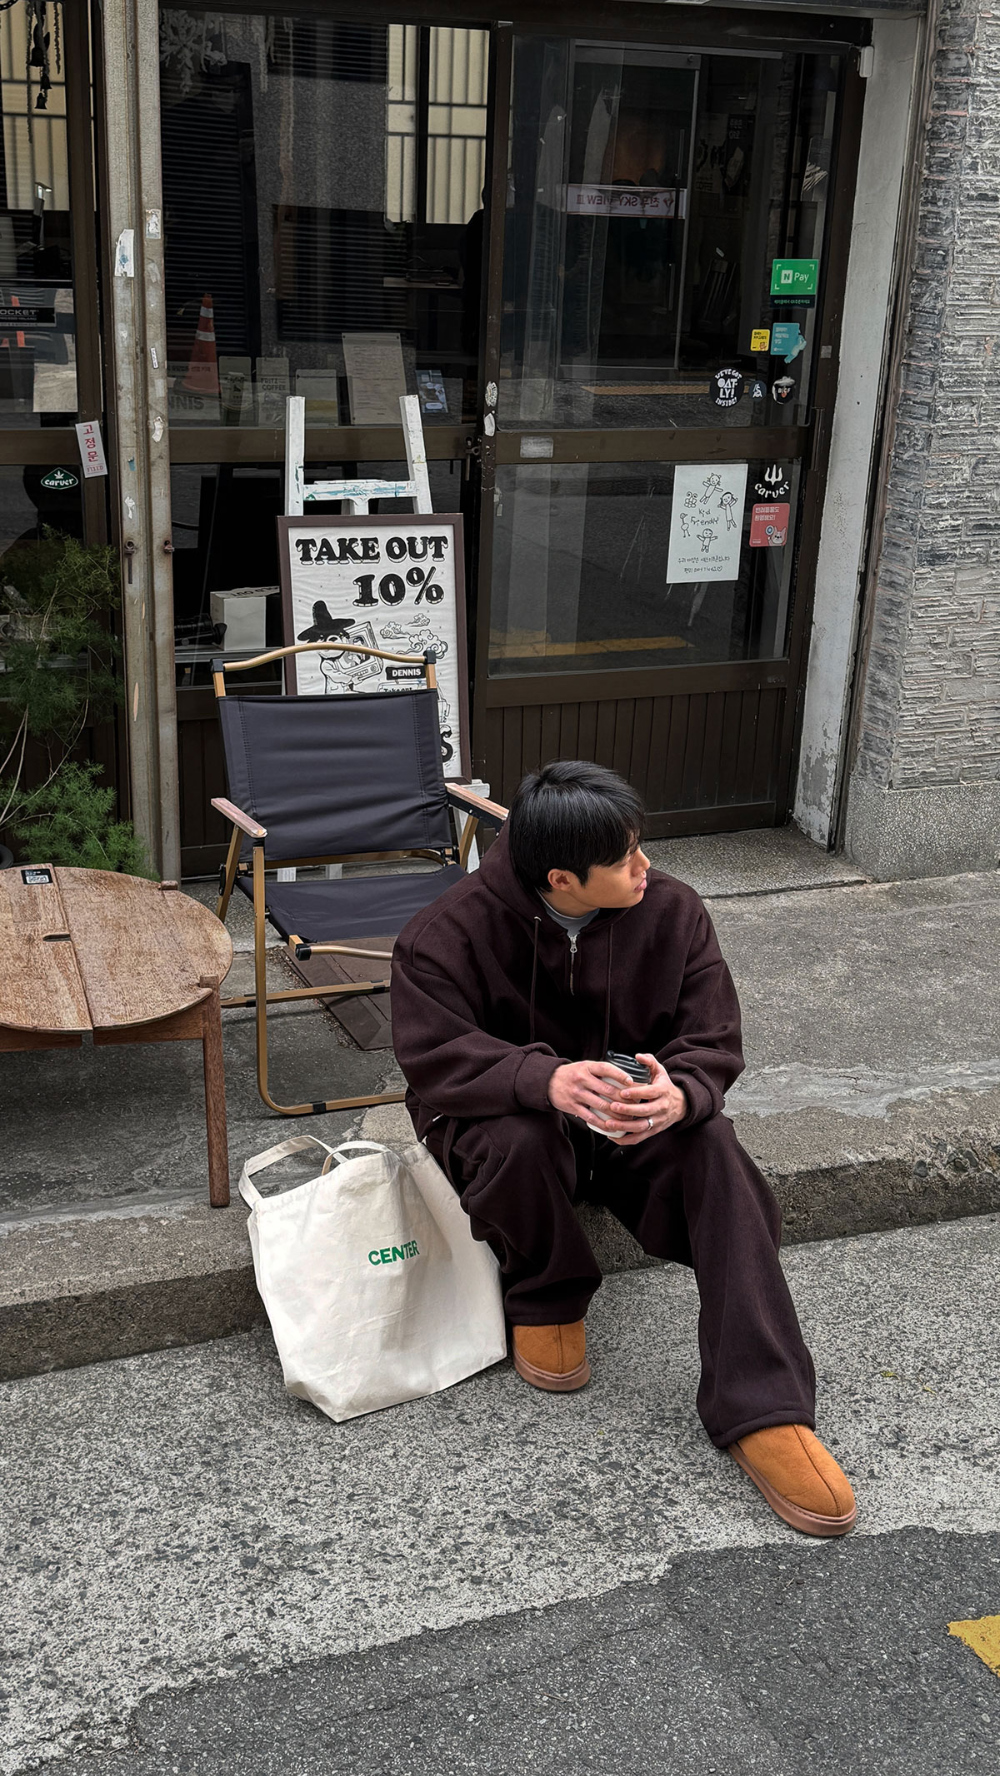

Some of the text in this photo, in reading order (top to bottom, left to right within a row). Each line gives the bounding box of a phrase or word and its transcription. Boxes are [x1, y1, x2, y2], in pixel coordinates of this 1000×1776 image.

[794, 272, 810, 283] Pay
[719, 388, 735, 399] LY!
[83, 424, 99, 463] 고정문
[44, 478, 74, 487] carver
[754, 481, 790, 499] carver
[295, 536, 449, 565] TAKE OUT
[352, 566, 444, 607] 10%
[391, 668, 422, 677] DENNIS
[368, 1240, 420, 1266] CENTER
